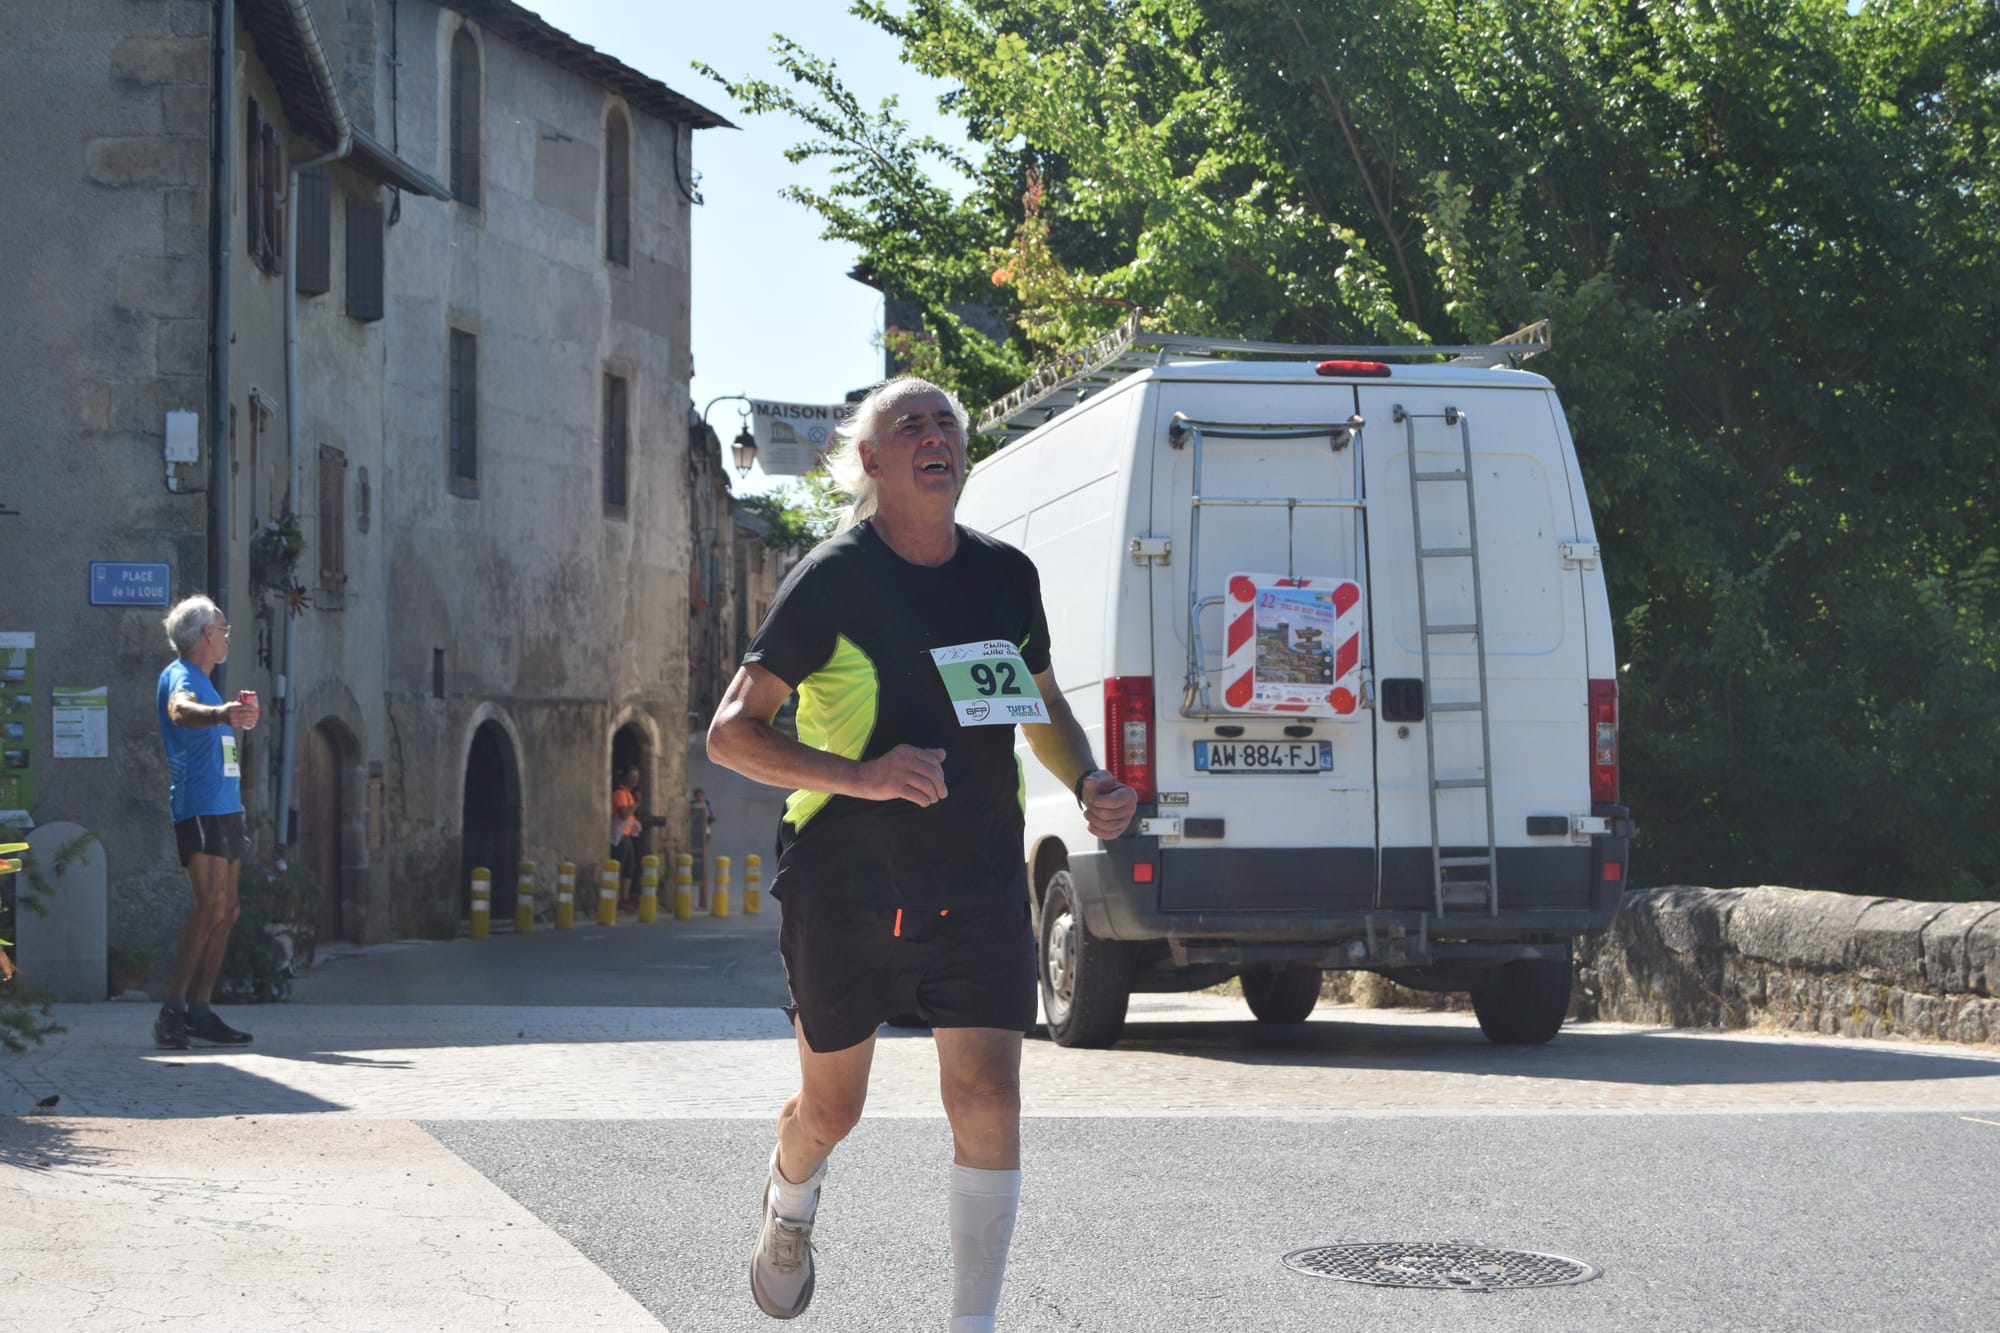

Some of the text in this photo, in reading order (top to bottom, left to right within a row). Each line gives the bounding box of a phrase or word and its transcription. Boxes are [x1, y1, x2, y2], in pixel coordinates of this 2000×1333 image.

[756, 403, 826, 420] MAISON
[122, 570, 153, 582] PLACE
[112, 586, 164, 598] de la LOUE
[1261, 593, 1276, 609] 22
[970, 662, 1022, 696] 92
[965, 706, 987, 716] BFP
[1210, 744, 1317, 767] AW-884-FJ
[1320, 756, 1331, 768] 42
